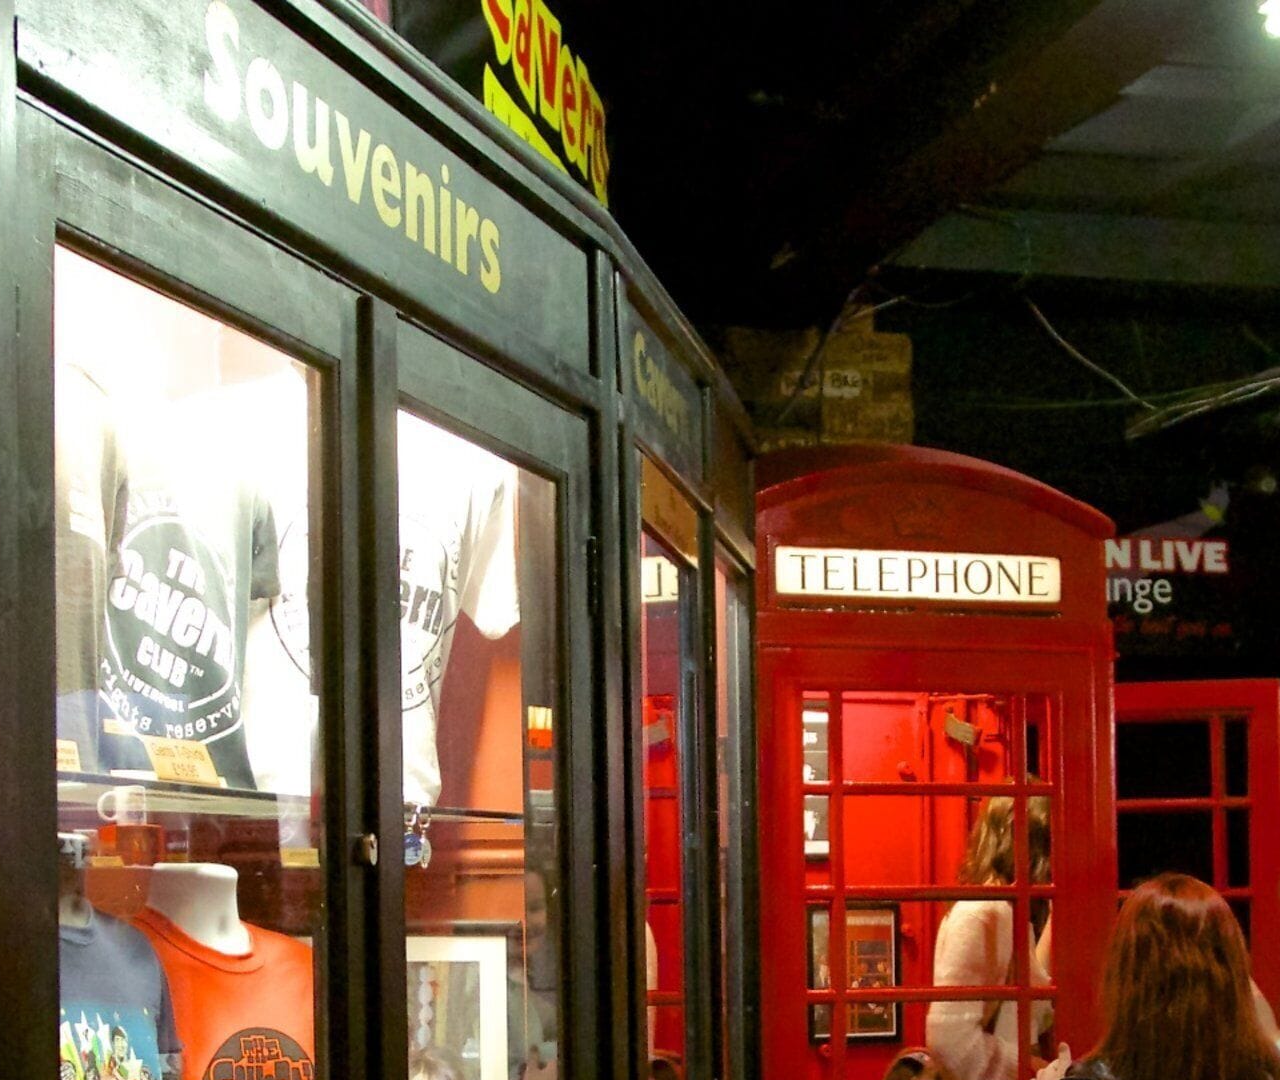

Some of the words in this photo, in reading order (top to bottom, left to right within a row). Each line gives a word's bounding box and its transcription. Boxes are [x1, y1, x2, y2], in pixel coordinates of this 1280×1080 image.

[203, 0, 502, 295] Souvenirs
[789, 552, 1051, 598] TELEPHONE
[1140, 540, 1228, 573] LIVE
